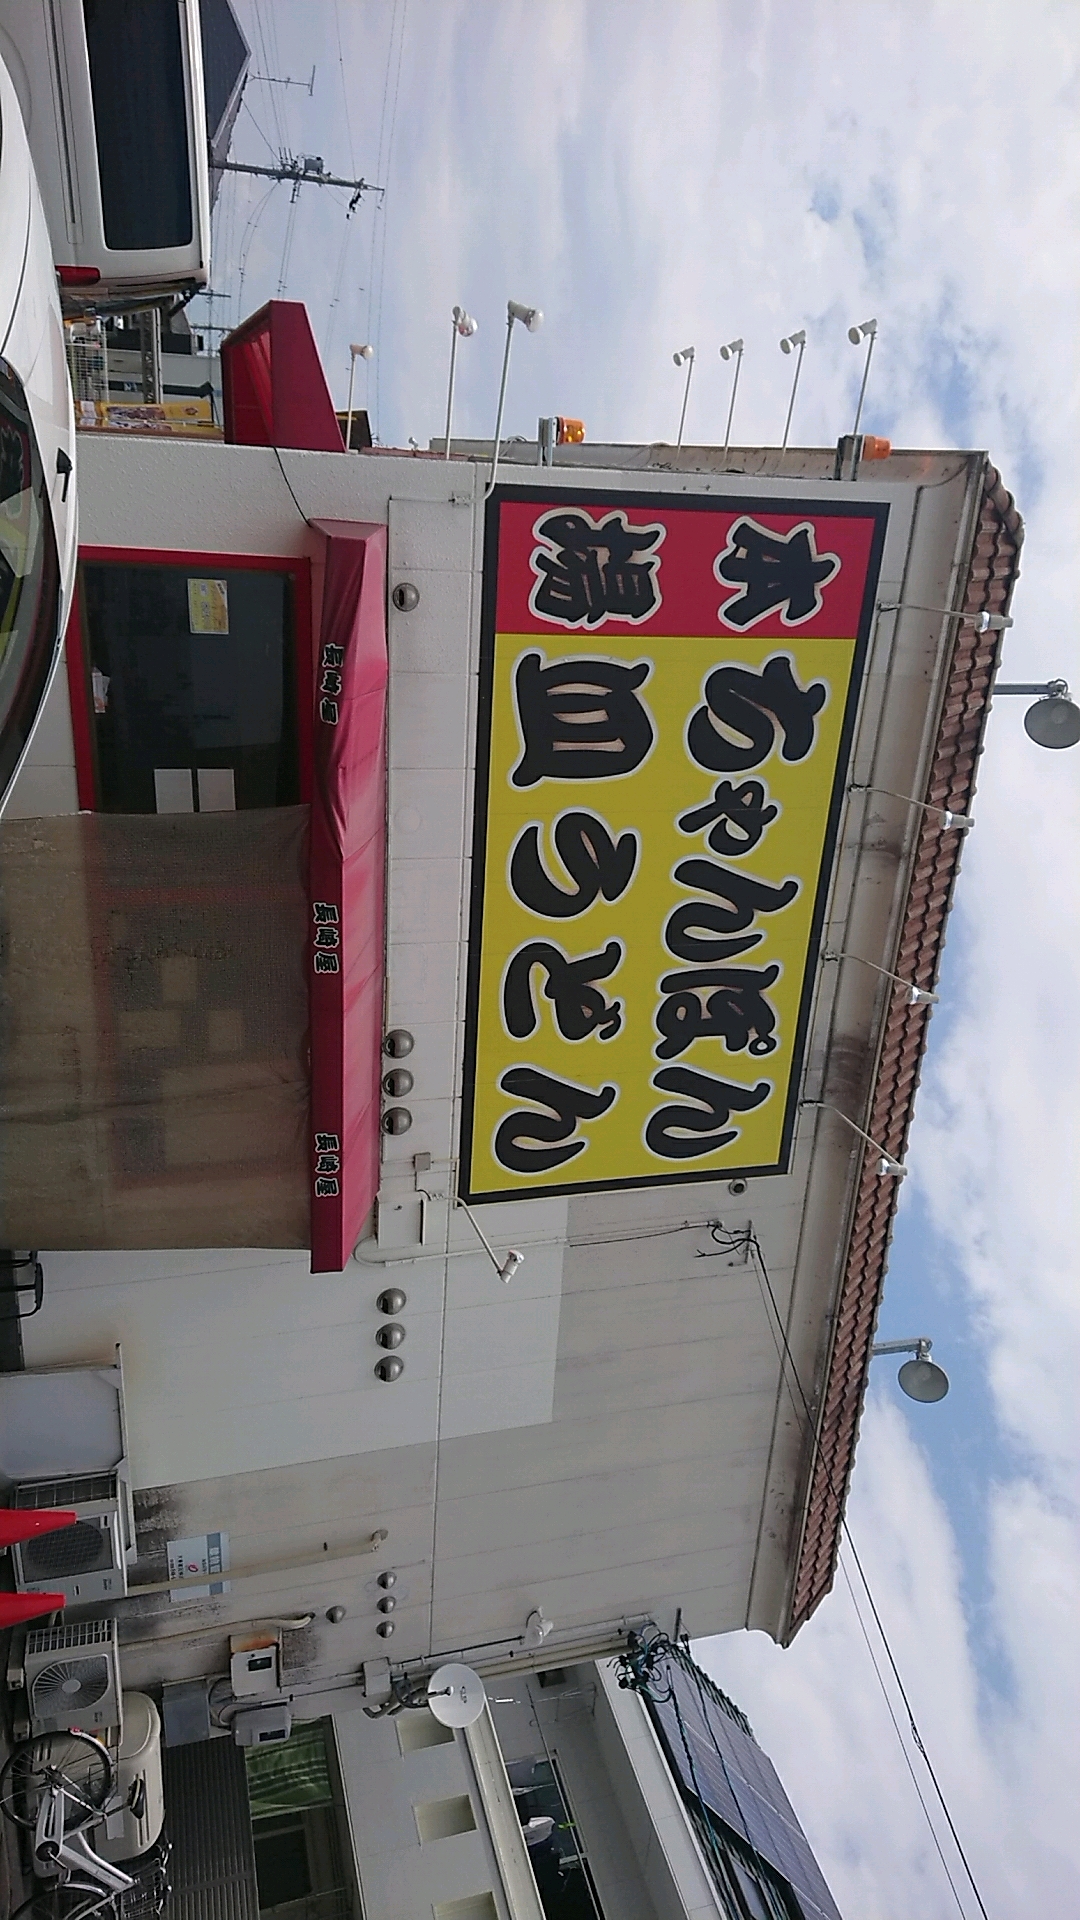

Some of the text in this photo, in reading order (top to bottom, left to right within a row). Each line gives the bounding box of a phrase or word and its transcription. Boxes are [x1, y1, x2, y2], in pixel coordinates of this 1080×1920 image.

[530, 510, 839, 632] 本場
[313, 902, 339, 974] 長崎屋
[493, 650, 656, 1176] 皿うどん
[643, 653, 830, 1162] ちゃんぽん
[314, 1133, 340, 1197] 長崎屋
